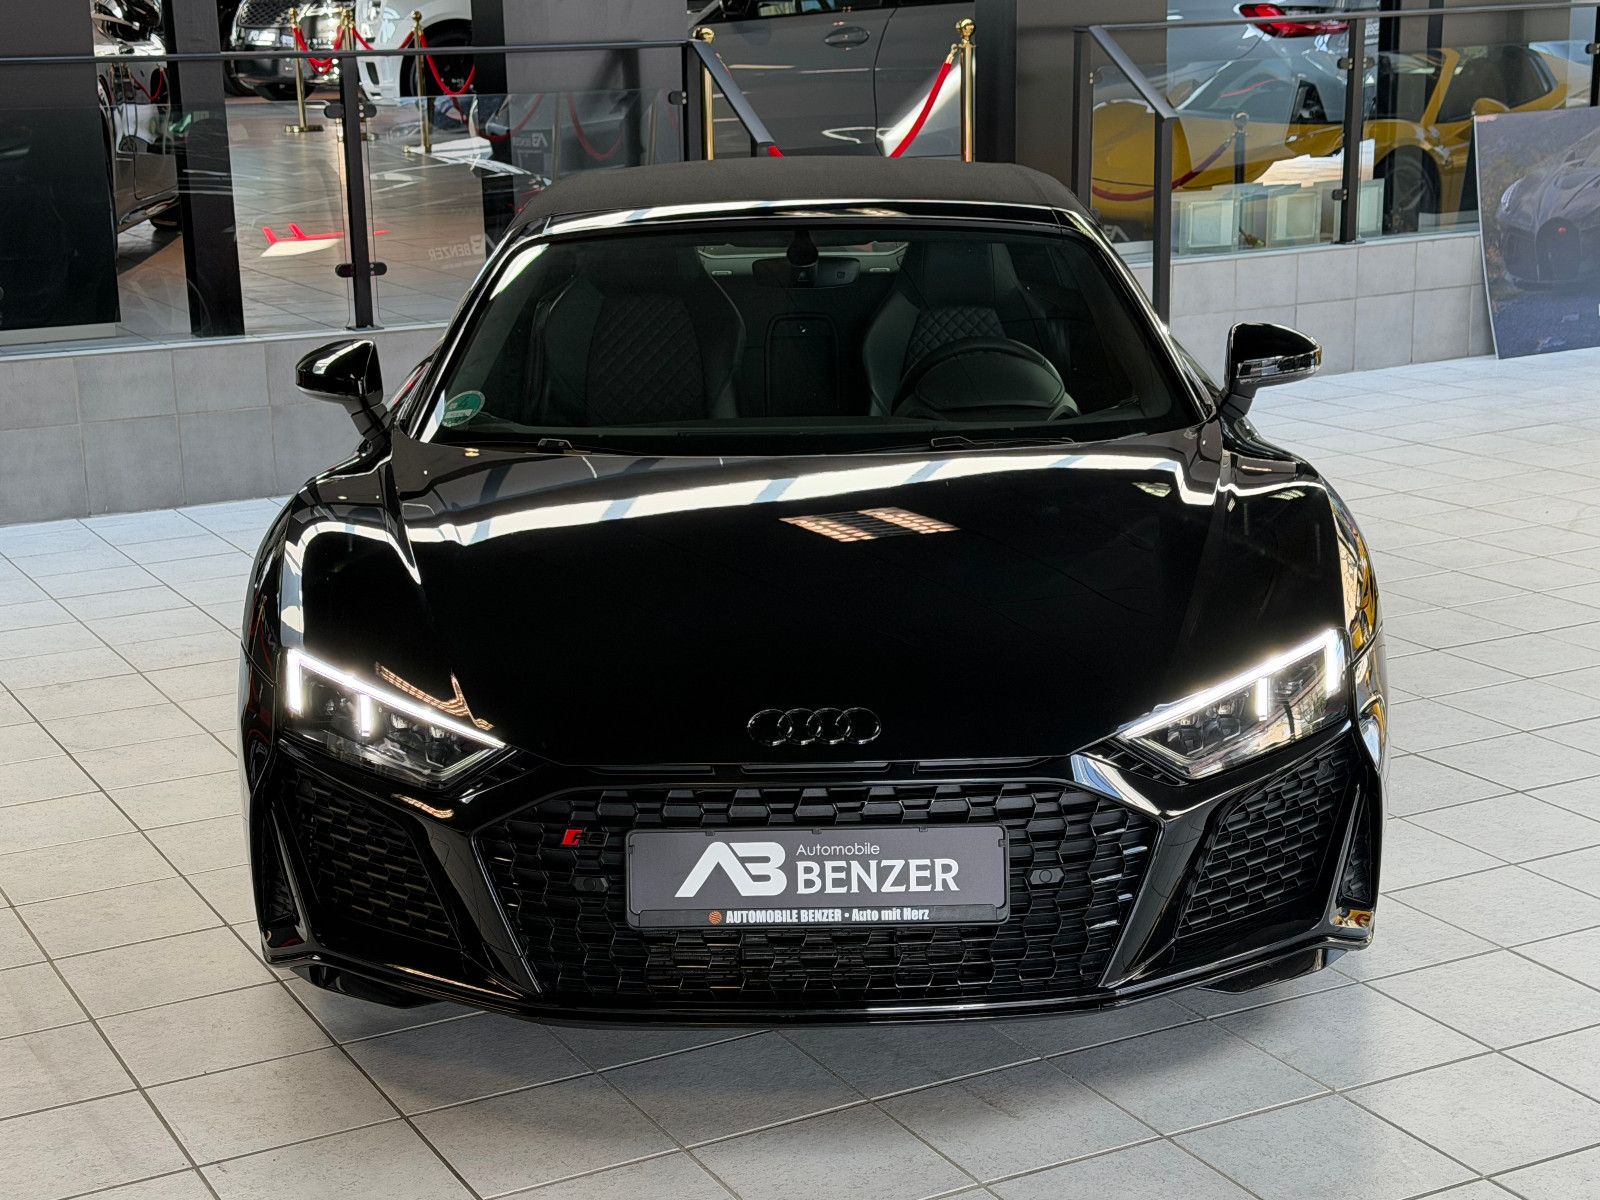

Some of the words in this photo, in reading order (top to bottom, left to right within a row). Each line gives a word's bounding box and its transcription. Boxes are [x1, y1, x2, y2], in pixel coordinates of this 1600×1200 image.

[795, 842, 881, 856] Automobile
[795, 858, 961, 894] BENZER
[725, 910, 799, 924] AUTOMOBILE
[800, 909, 842, 923] BENZER
[852, 908, 879, 921] Auto
[881, 907, 901, 921] mit
[903, 907, 930, 920] Herz
